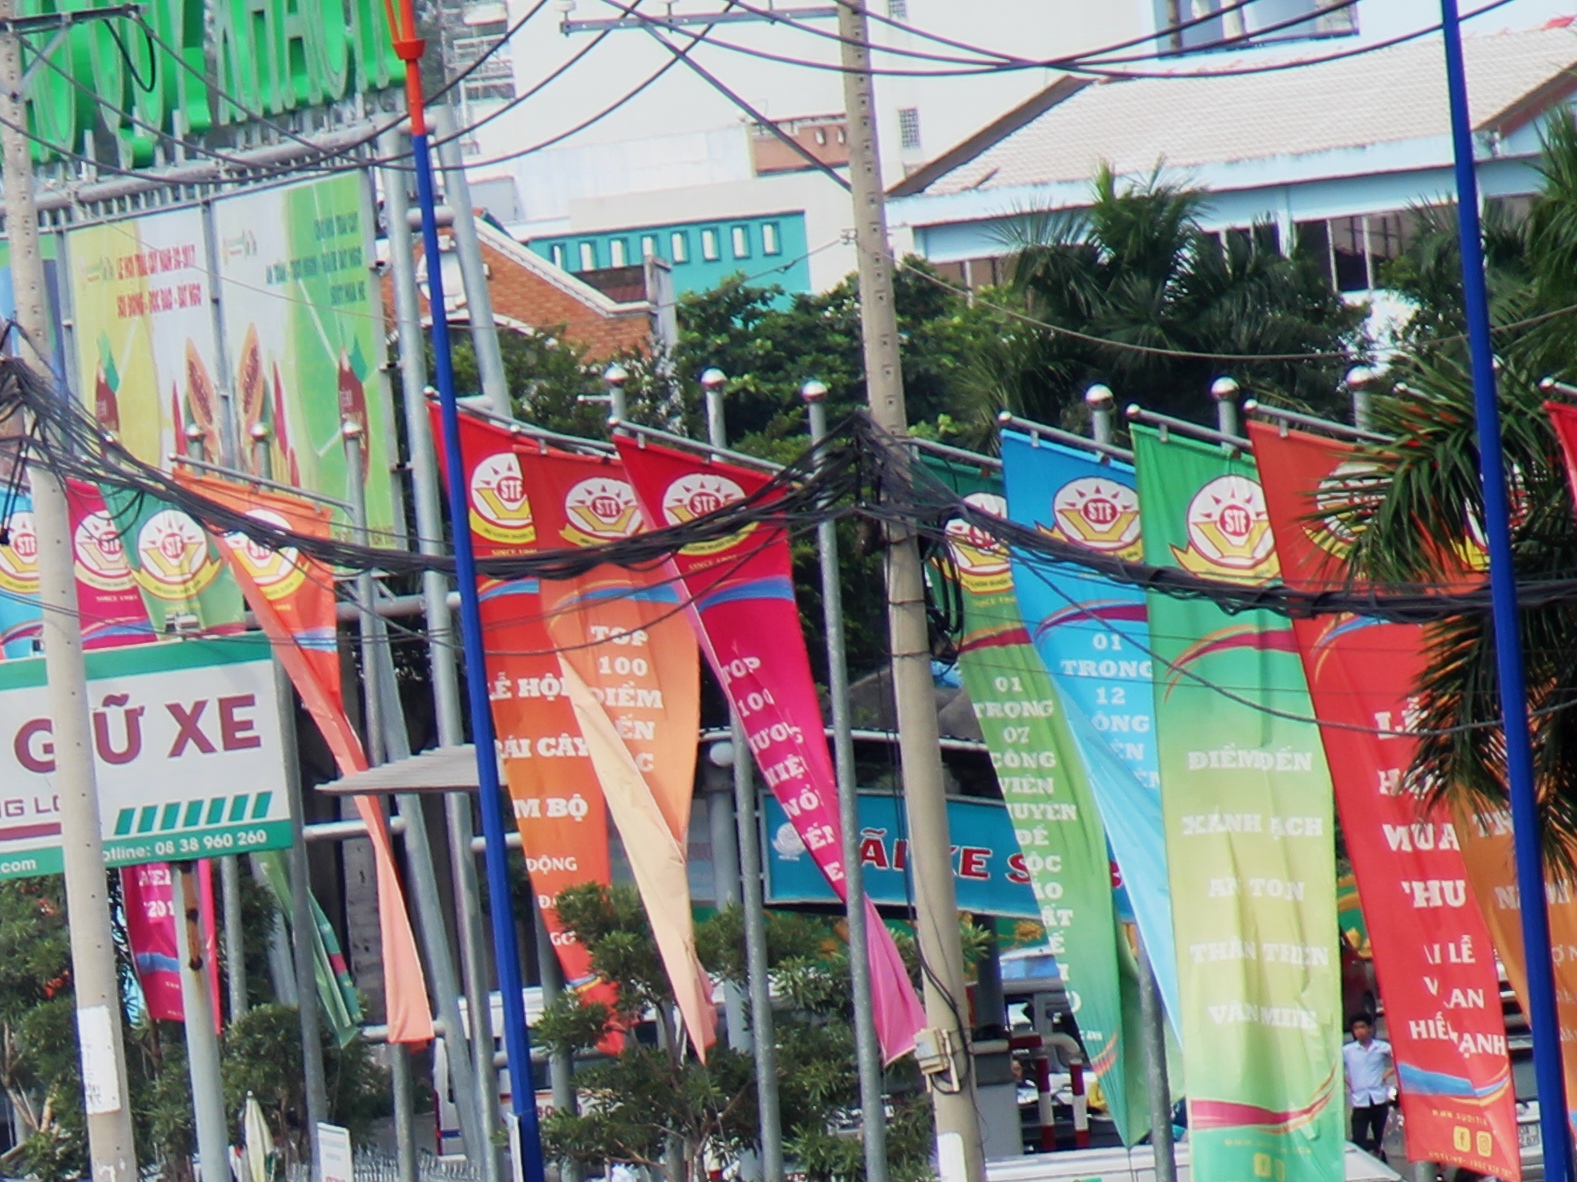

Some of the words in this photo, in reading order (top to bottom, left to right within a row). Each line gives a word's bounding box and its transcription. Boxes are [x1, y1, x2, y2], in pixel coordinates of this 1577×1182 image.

[598, 498, 621, 516] STF
[693, 494, 718, 514] STF
[1087, 498, 1116, 526] STF
[1223, 503, 1251, 534] STF
[591, 626, 649, 647] TOP
[1092, 634, 1122, 650] 01
[599, 656, 648, 677] 100
[1094, 687, 1126, 705] 12
[13, 693, 146, 774] GỮ
[165, 693, 262, 758] XE
[614, 714, 655, 741] ẾN
[1093, 712, 1150, 733] ÔNG
[546, 793, 589, 822] BỘ
[1269, 815, 1324, 840] ẠCH
[155, 838, 176, 856] 08
[179, 837, 201, 854] 38
[203, 833, 234, 852] 960
[237, 828, 268, 847] 260
[860, 827, 910, 872] ÃI
[1401, 879, 1467, 908] HU
[1448, 934, 1476, 965] LỄ
[1444, 986, 1485, 1009] AN
[1458, 1032, 1508, 1058] ẠNH
